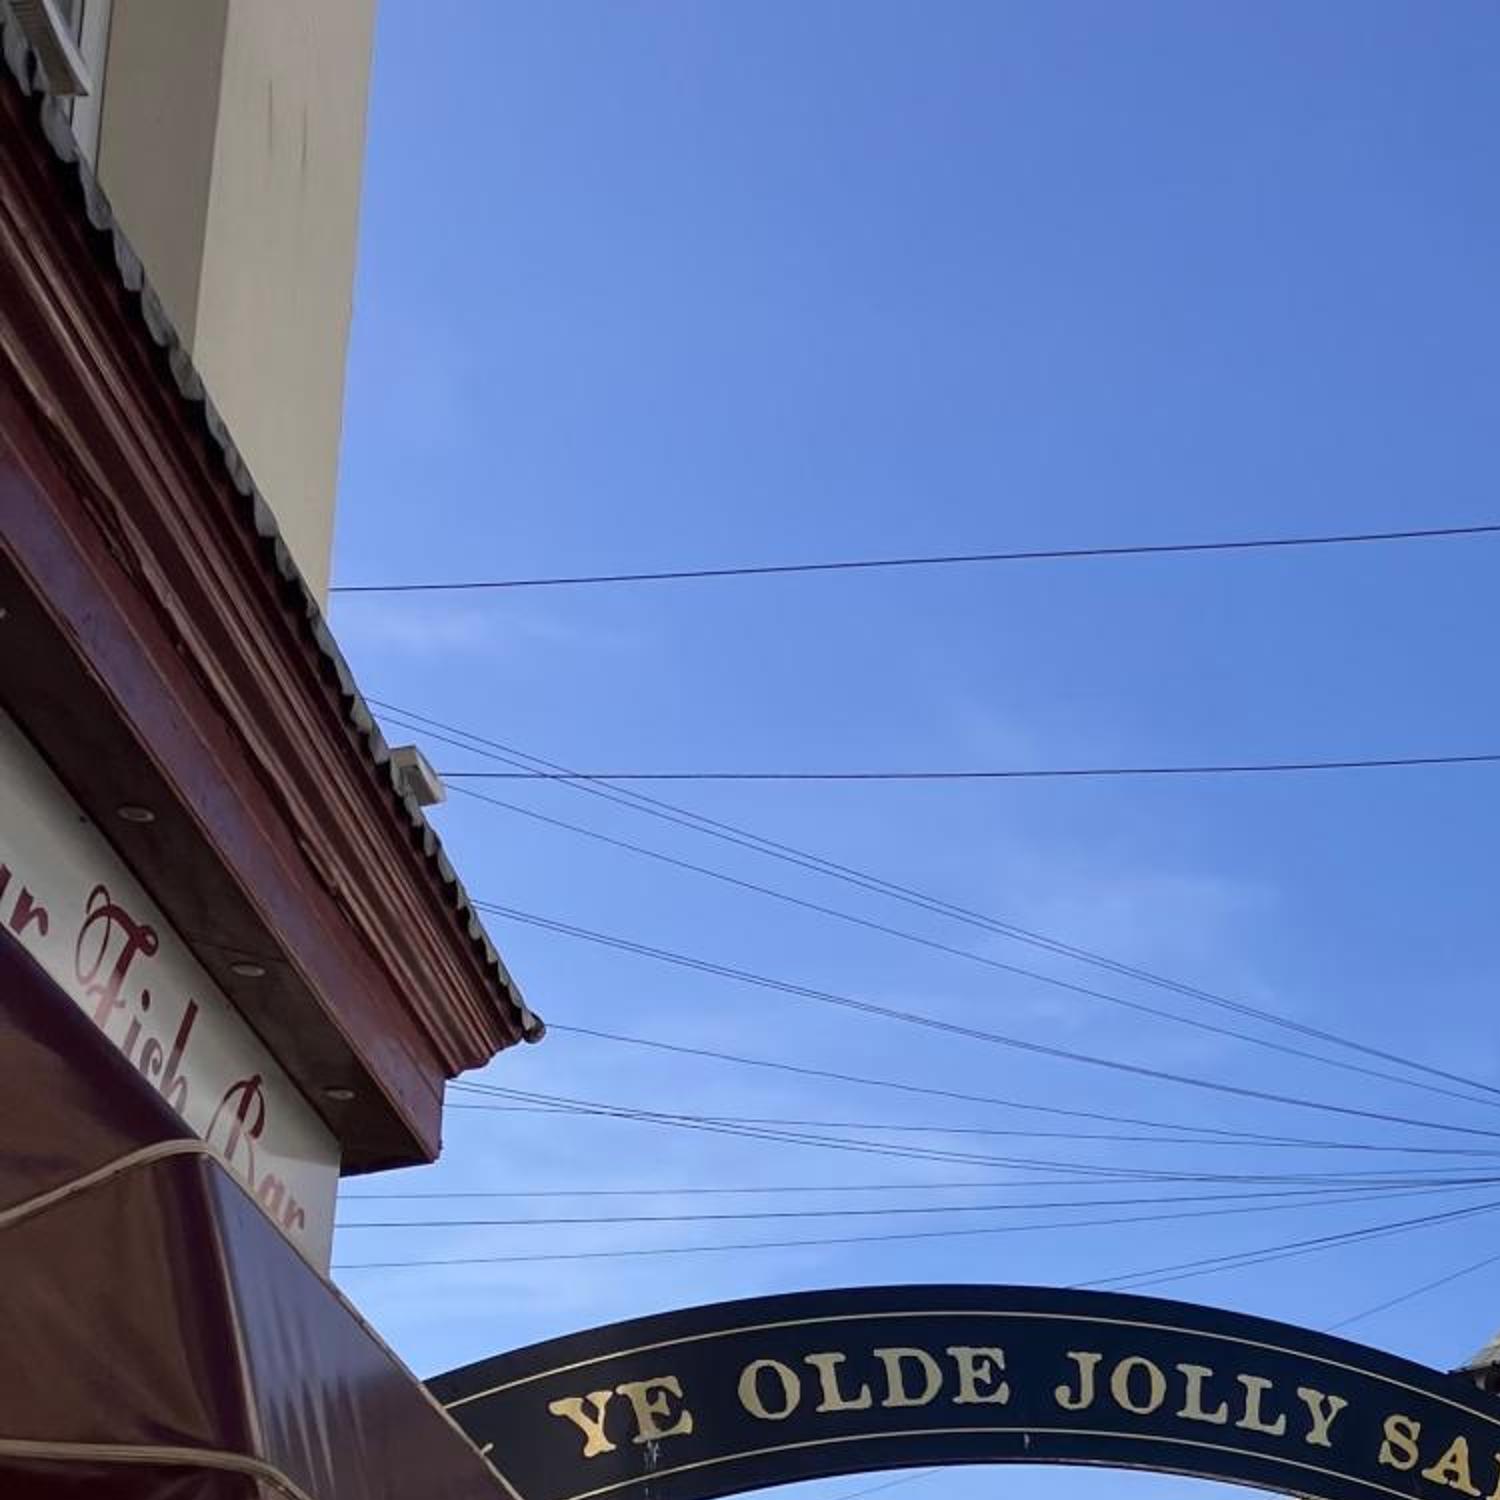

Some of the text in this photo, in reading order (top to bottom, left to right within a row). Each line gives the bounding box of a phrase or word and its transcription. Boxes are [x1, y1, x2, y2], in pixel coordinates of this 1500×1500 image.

[548, 1375, 693, 1459] YE
[737, 1346, 1011, 1422] OLDE
[1055, 1350, 1348, 1448] JOLLY
